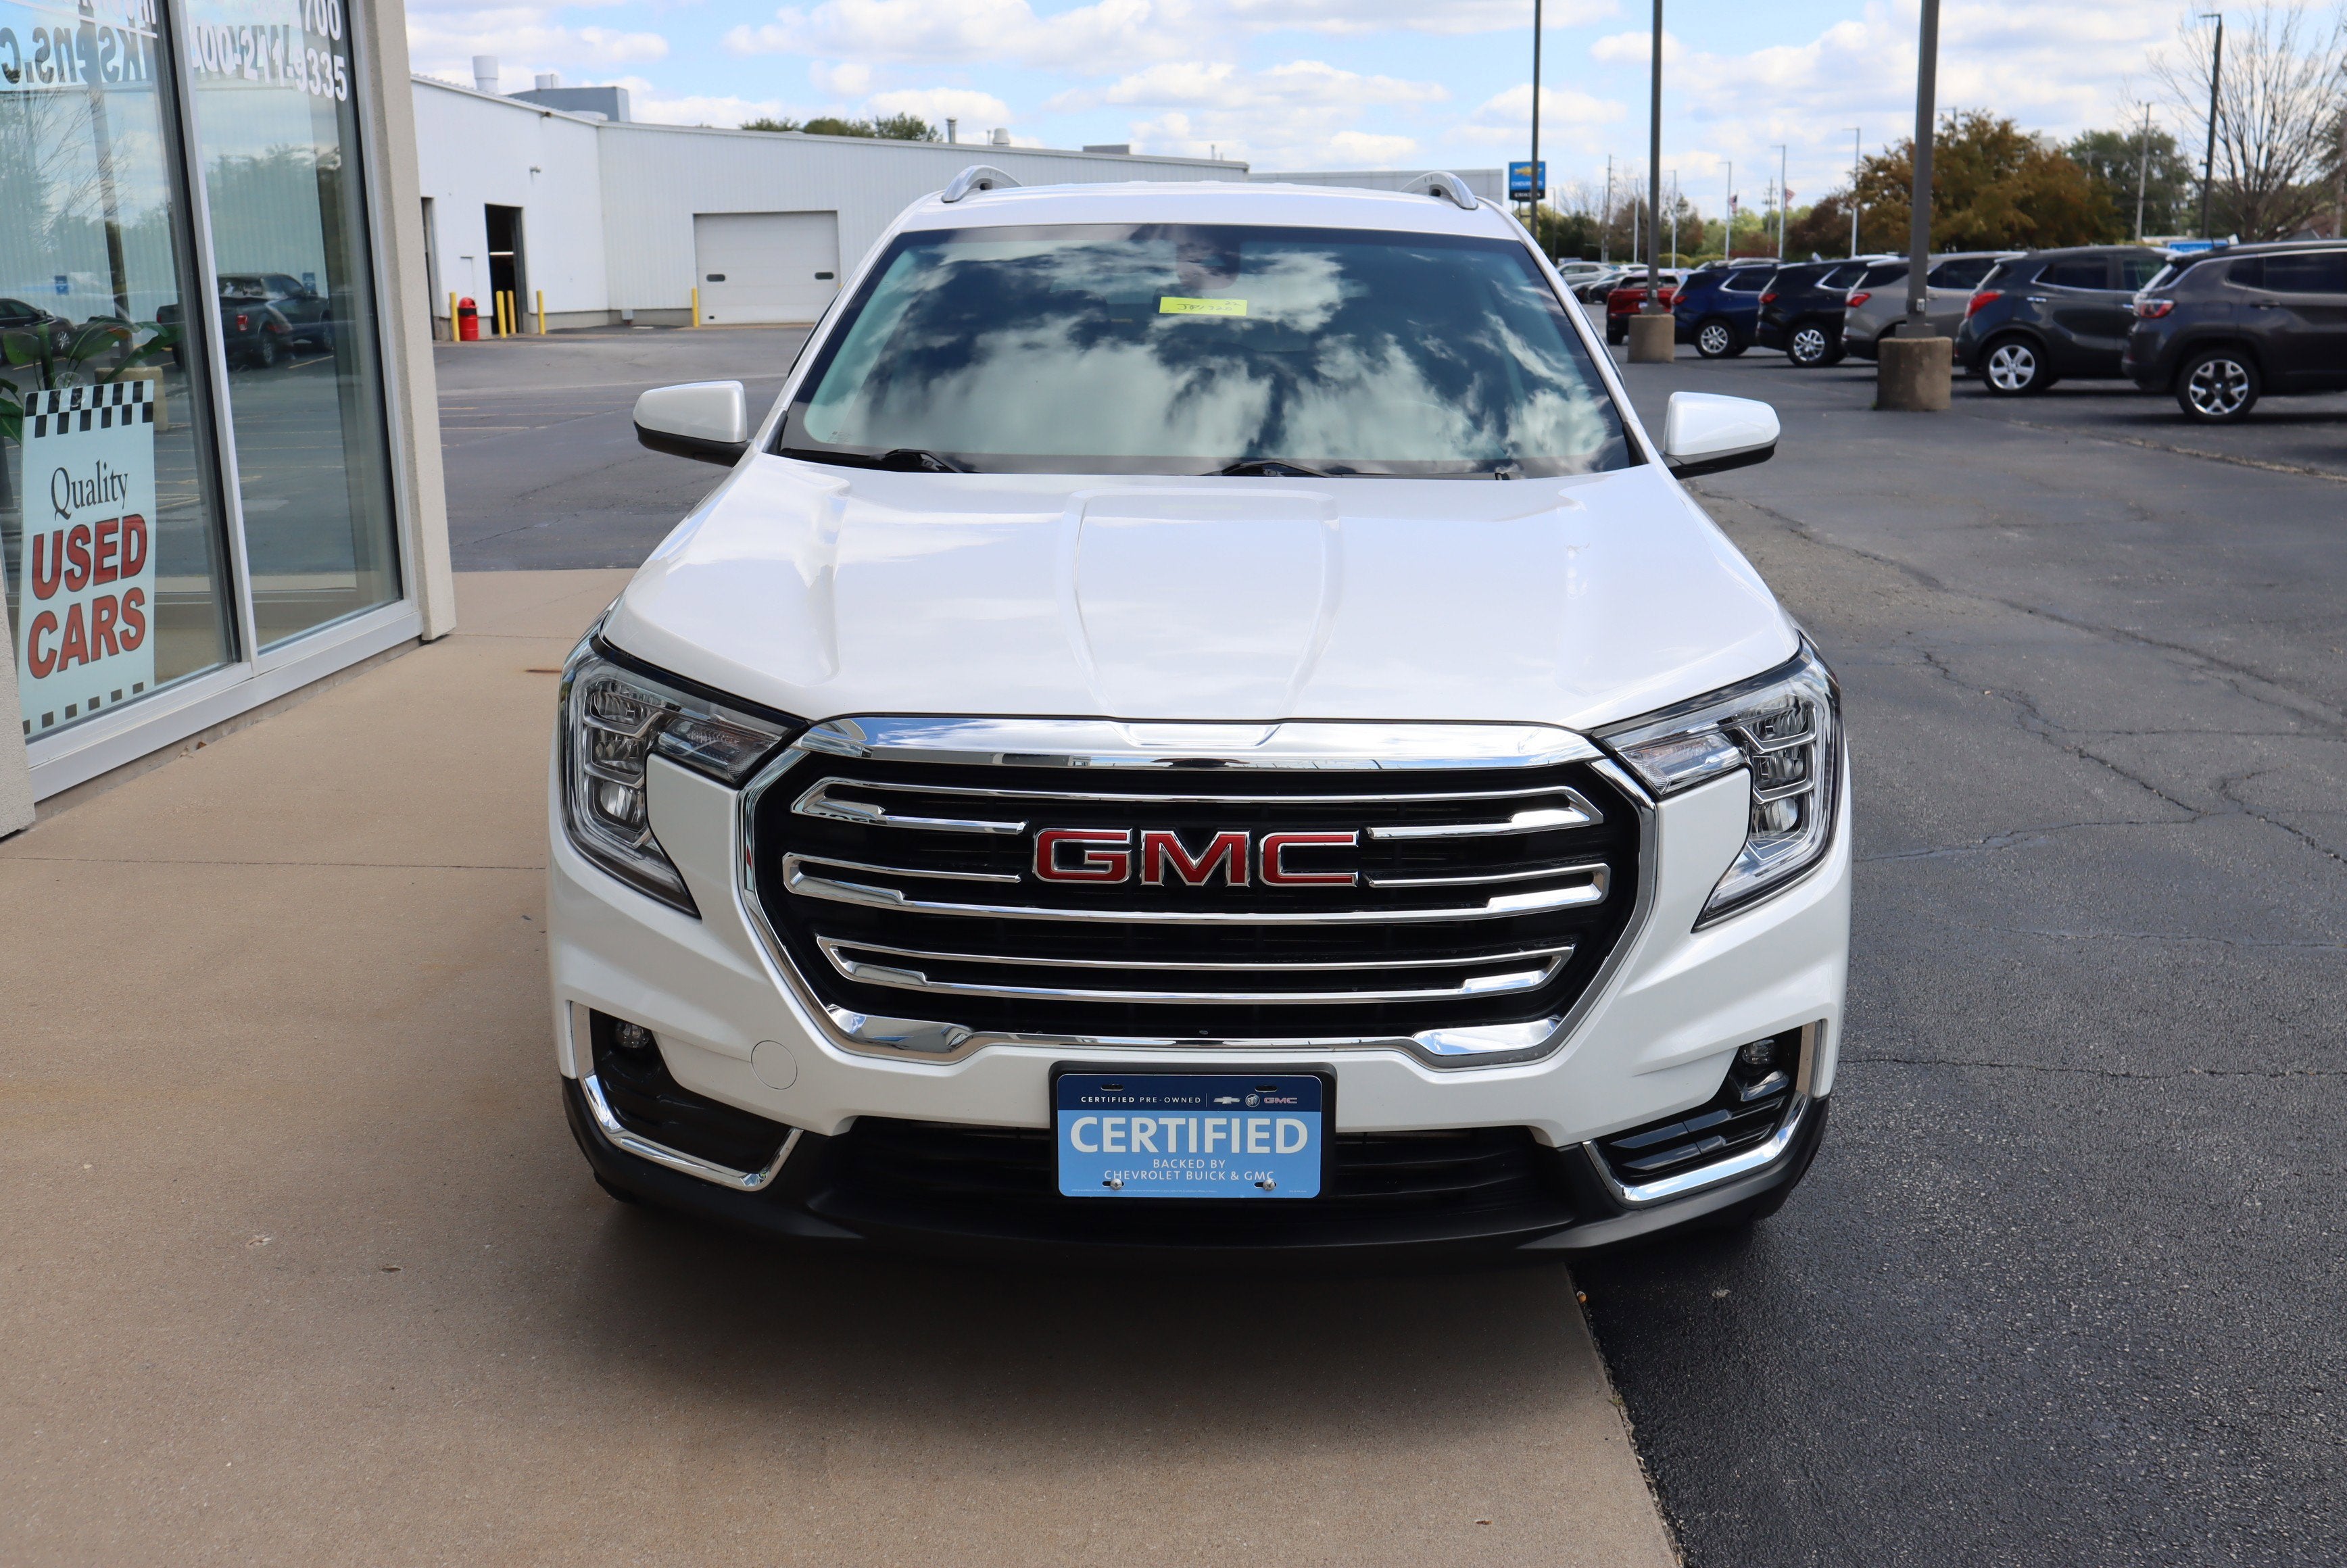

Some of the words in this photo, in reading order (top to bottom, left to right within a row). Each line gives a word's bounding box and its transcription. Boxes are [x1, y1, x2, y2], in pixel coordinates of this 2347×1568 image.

[51, 460, 128, 520] Quality
[32, 514, 147, 601] USED
[28, 587, 145, 679] CARS
[1032, 828, 1359, 887] GMC
[1070, 1117, 1308, 1154] CERTIFIED
[1153, 1159, 1205, 1169] BACKED
[1211, 1160, 1226, 1169] BY
[1105, 1170, 1181, 1180] CHEVROLET
[1186, 1171, 1226, 1180] BUICK
[1230, 1171, 1239, 1181] &
[1244, 1171, 1275, 1181] GMC
